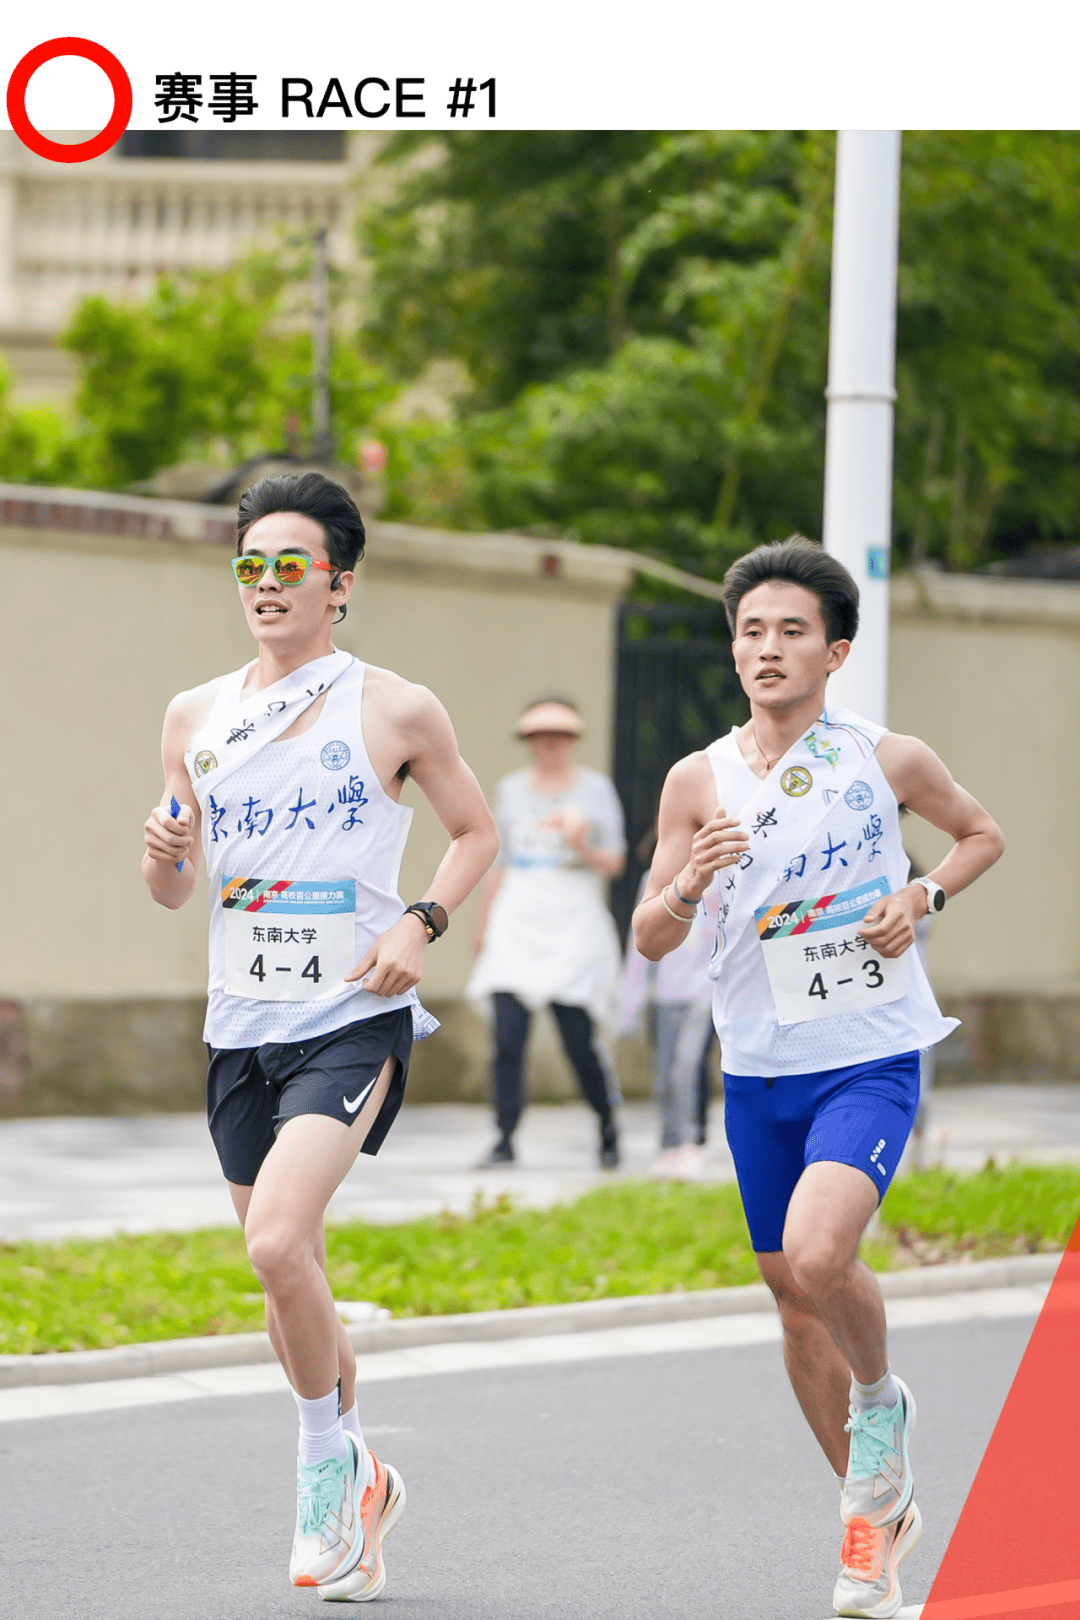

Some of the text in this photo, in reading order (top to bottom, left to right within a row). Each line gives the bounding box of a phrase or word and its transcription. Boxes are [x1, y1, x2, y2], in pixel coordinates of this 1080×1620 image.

[229, 887, 254, 901] 2024
[767, 913, 800, 928] 2024
[252, 926, 317, 944] 东南大学
